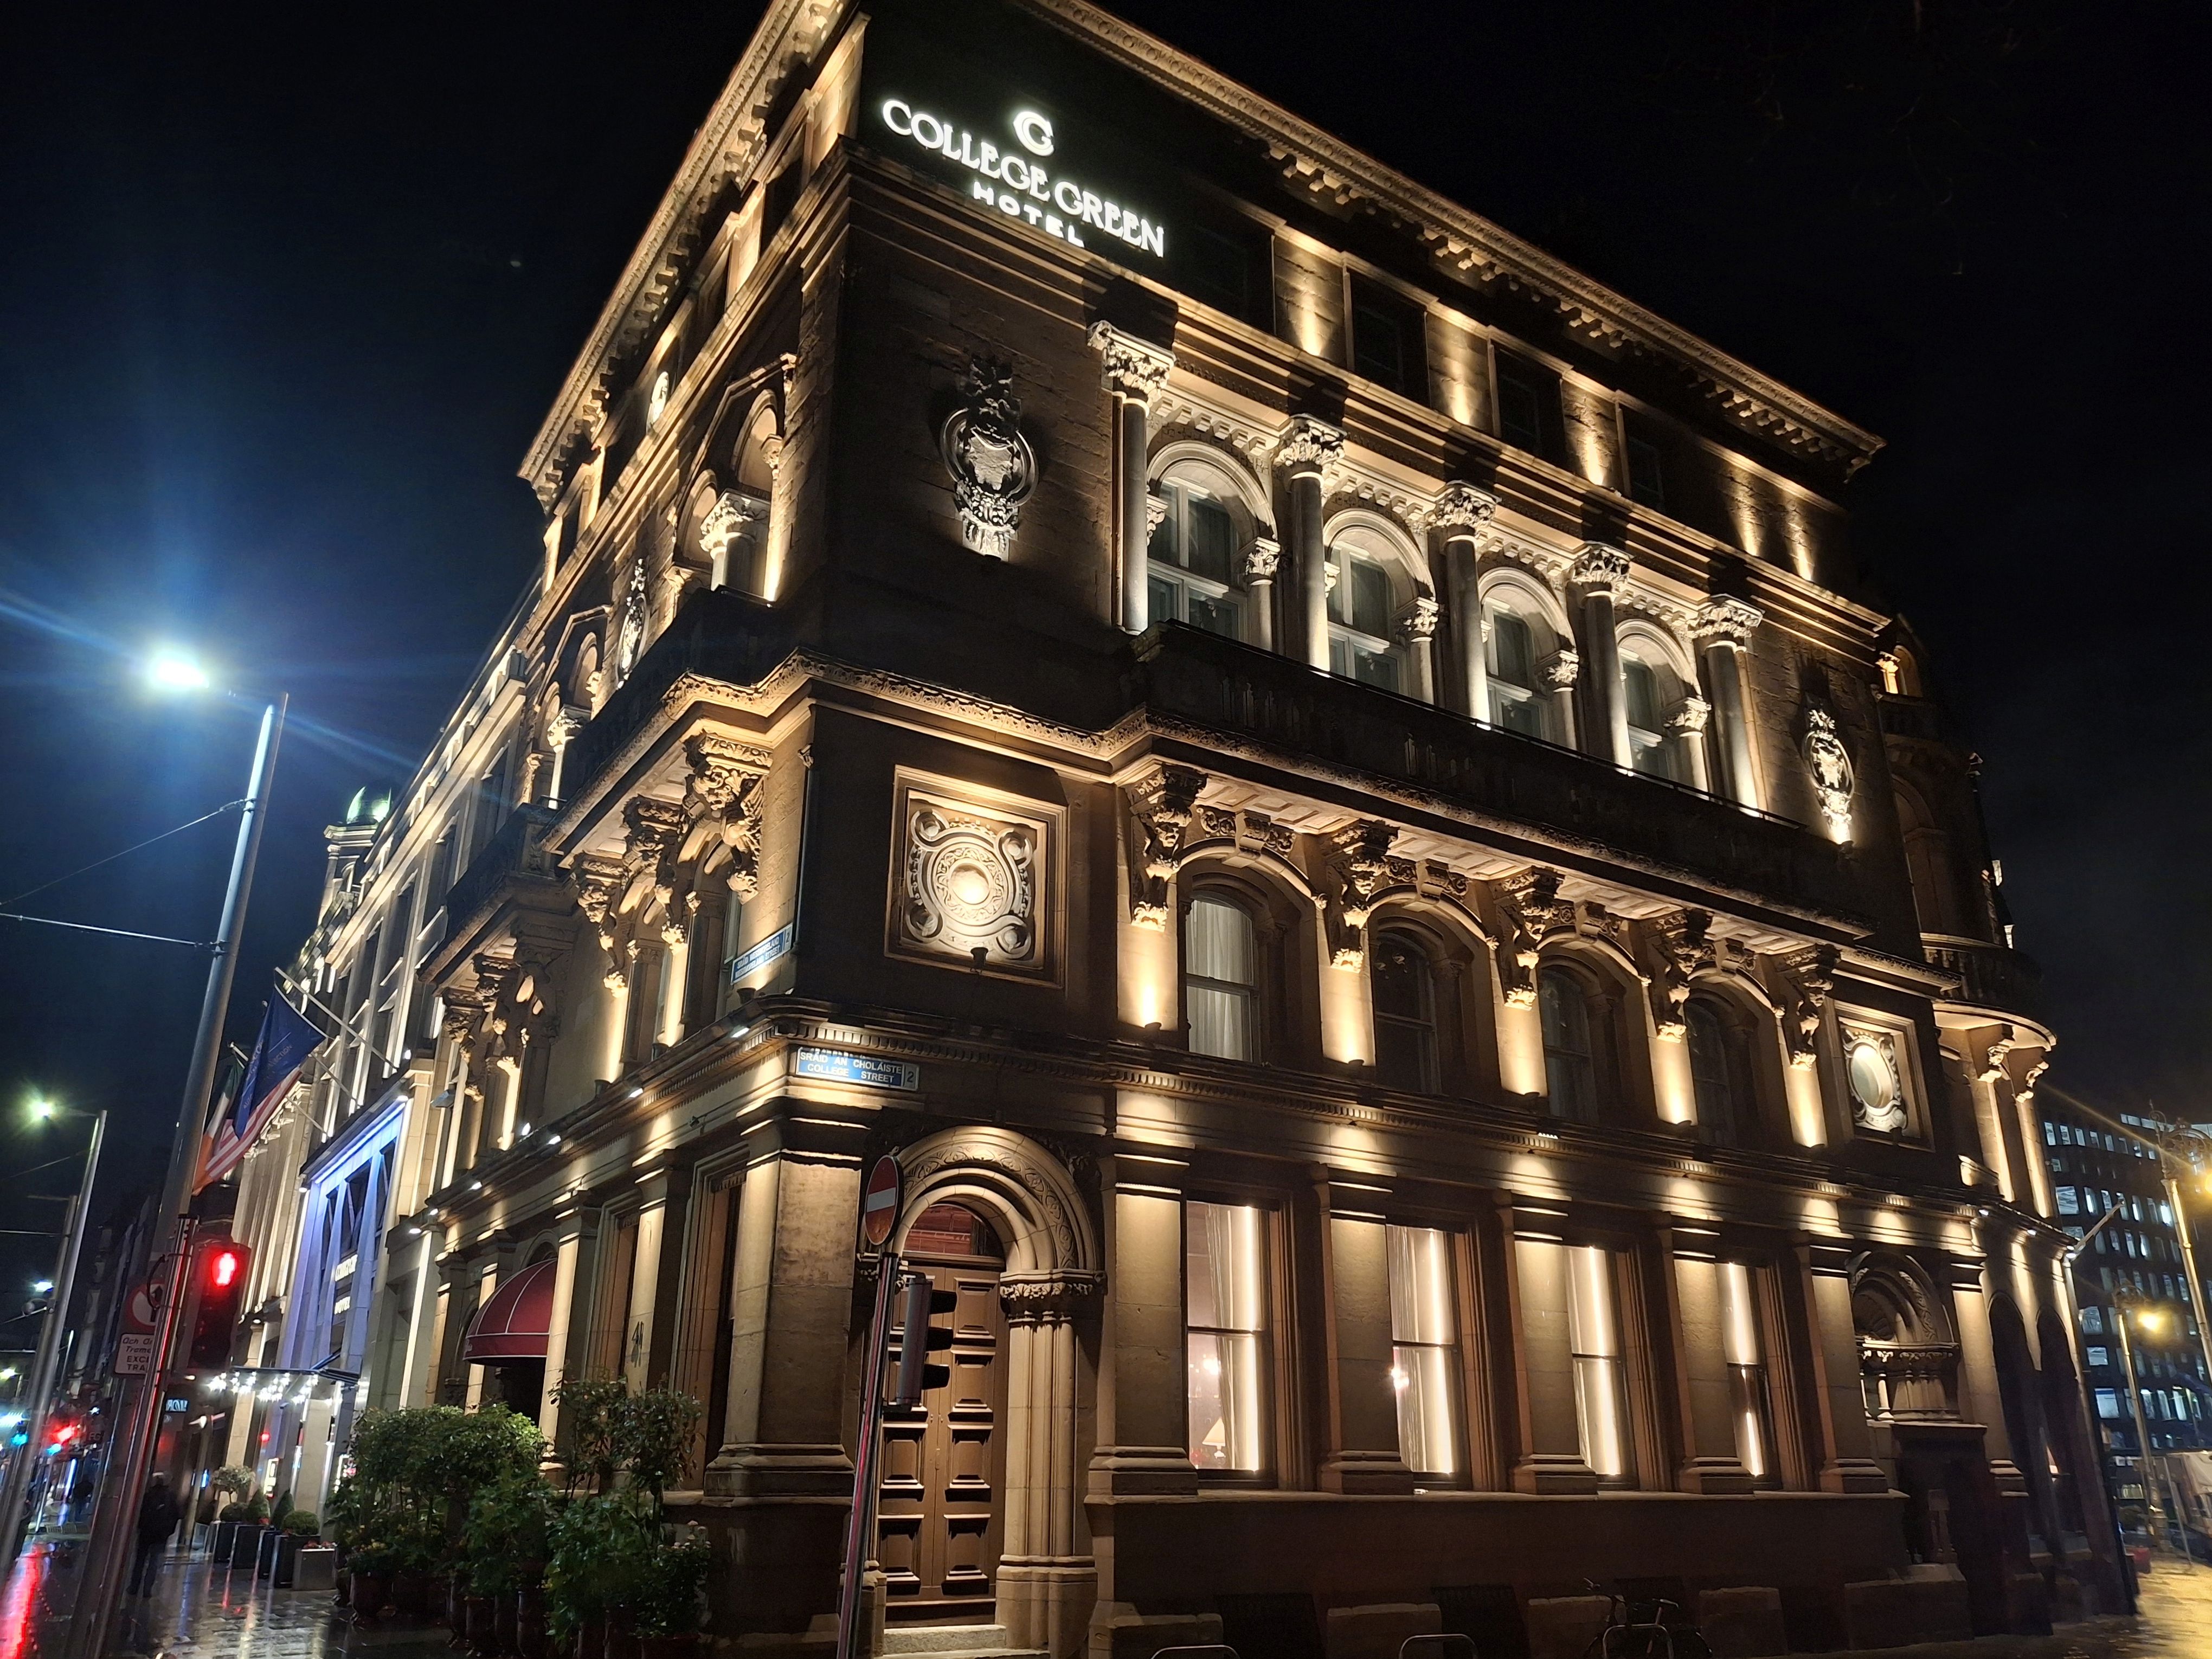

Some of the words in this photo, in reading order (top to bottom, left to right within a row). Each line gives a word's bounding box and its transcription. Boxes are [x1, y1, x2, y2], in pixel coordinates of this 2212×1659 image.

[882, 99, 1051, 202] COLLEGE
[1054, 181, 1164, 258] GREEN
[973, 181, 1084, 248] HOTEL
[786, 933, 790, 943] 2
[807, 1063, 850, 1077] COLLEGE
[861, 1071, 895, 1083] STREET
[834, 1056, 848, 1066] AN
[853, 1059, 902, 1074] CHOLÁISTE
[906, 1071, 914, 1083] 2
